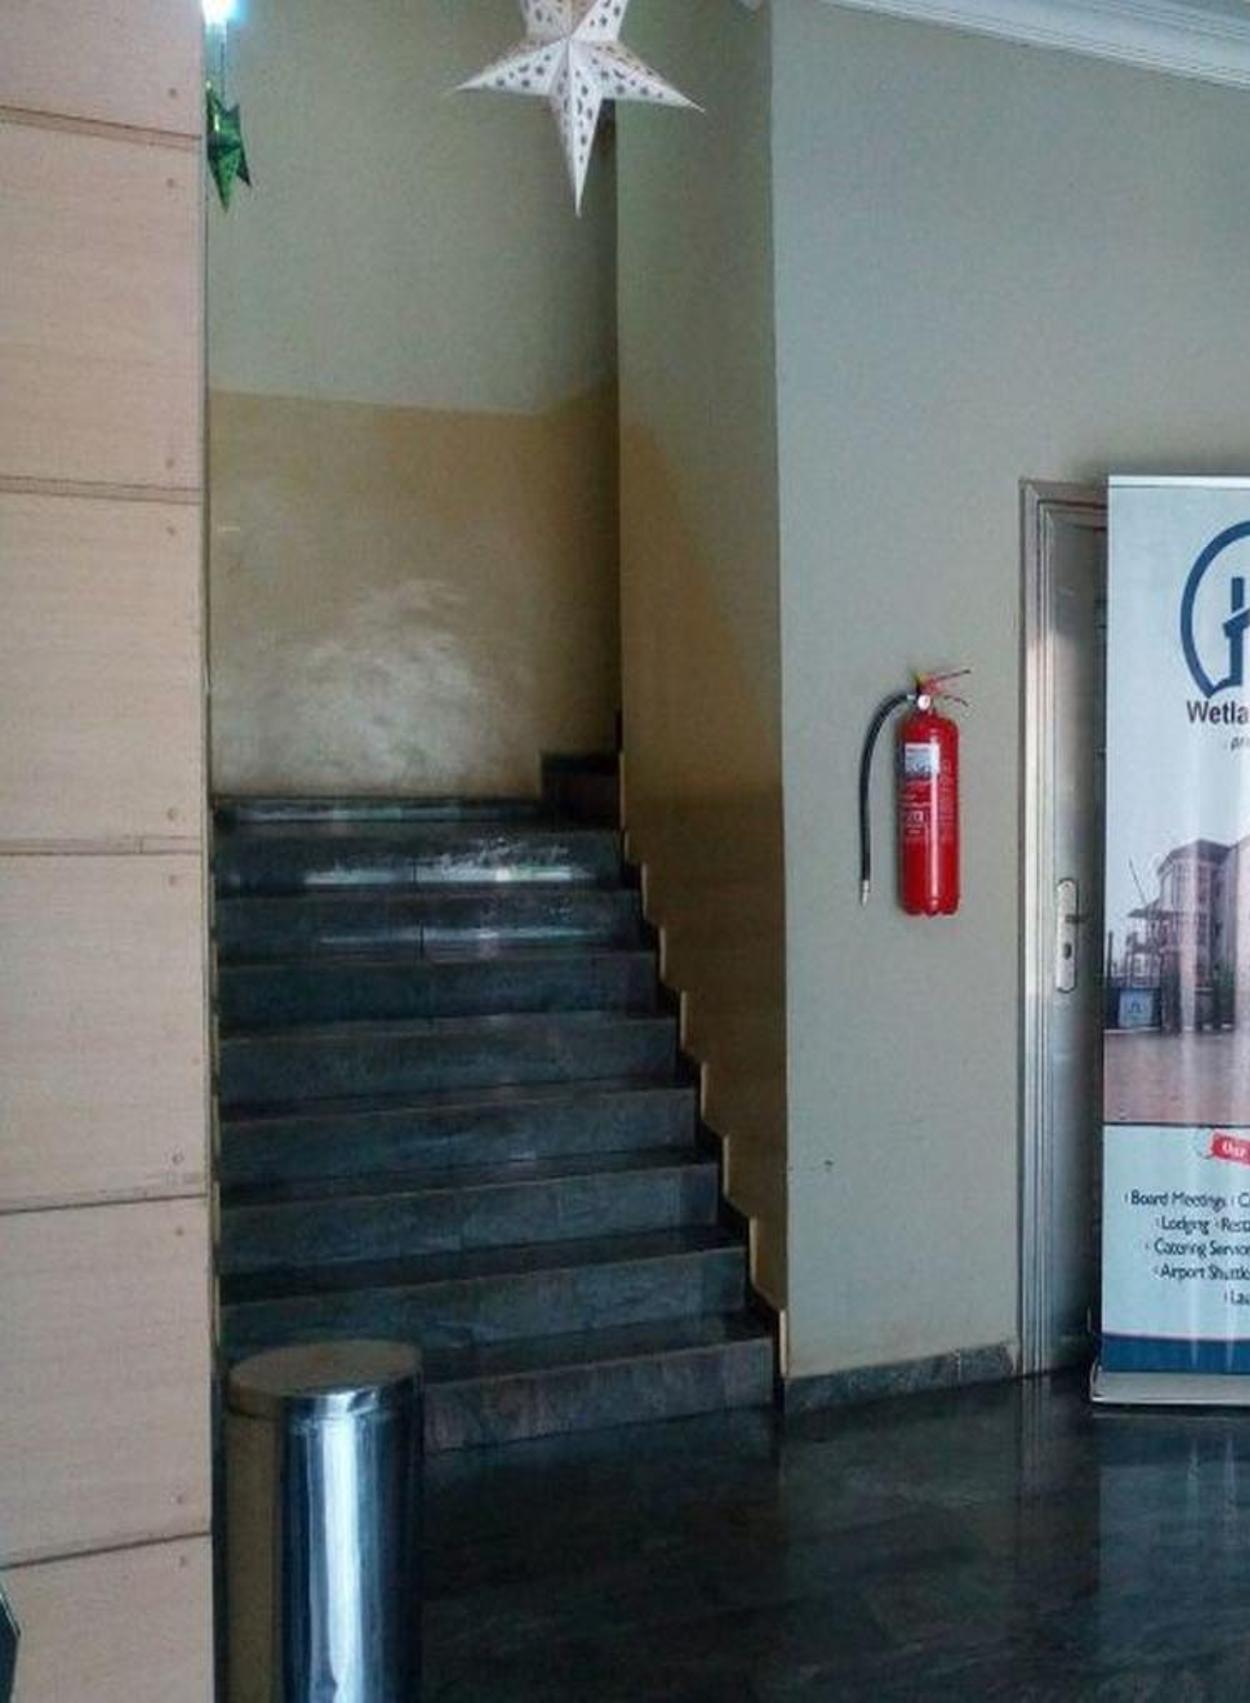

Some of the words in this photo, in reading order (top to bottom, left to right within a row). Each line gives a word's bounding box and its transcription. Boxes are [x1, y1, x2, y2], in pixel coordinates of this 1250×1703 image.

[1131, 1189, 1168, 1206] Board
[1171, 1191, 1227, 1213] Meetings
[1161, 1215, 1209, 1235] Lodging
[1154, 1237, 1207, 1258] Catering
[1160, 1263, 1206, 1284] Airport
[1208, 1264, 1250, 1281] Shuttle
